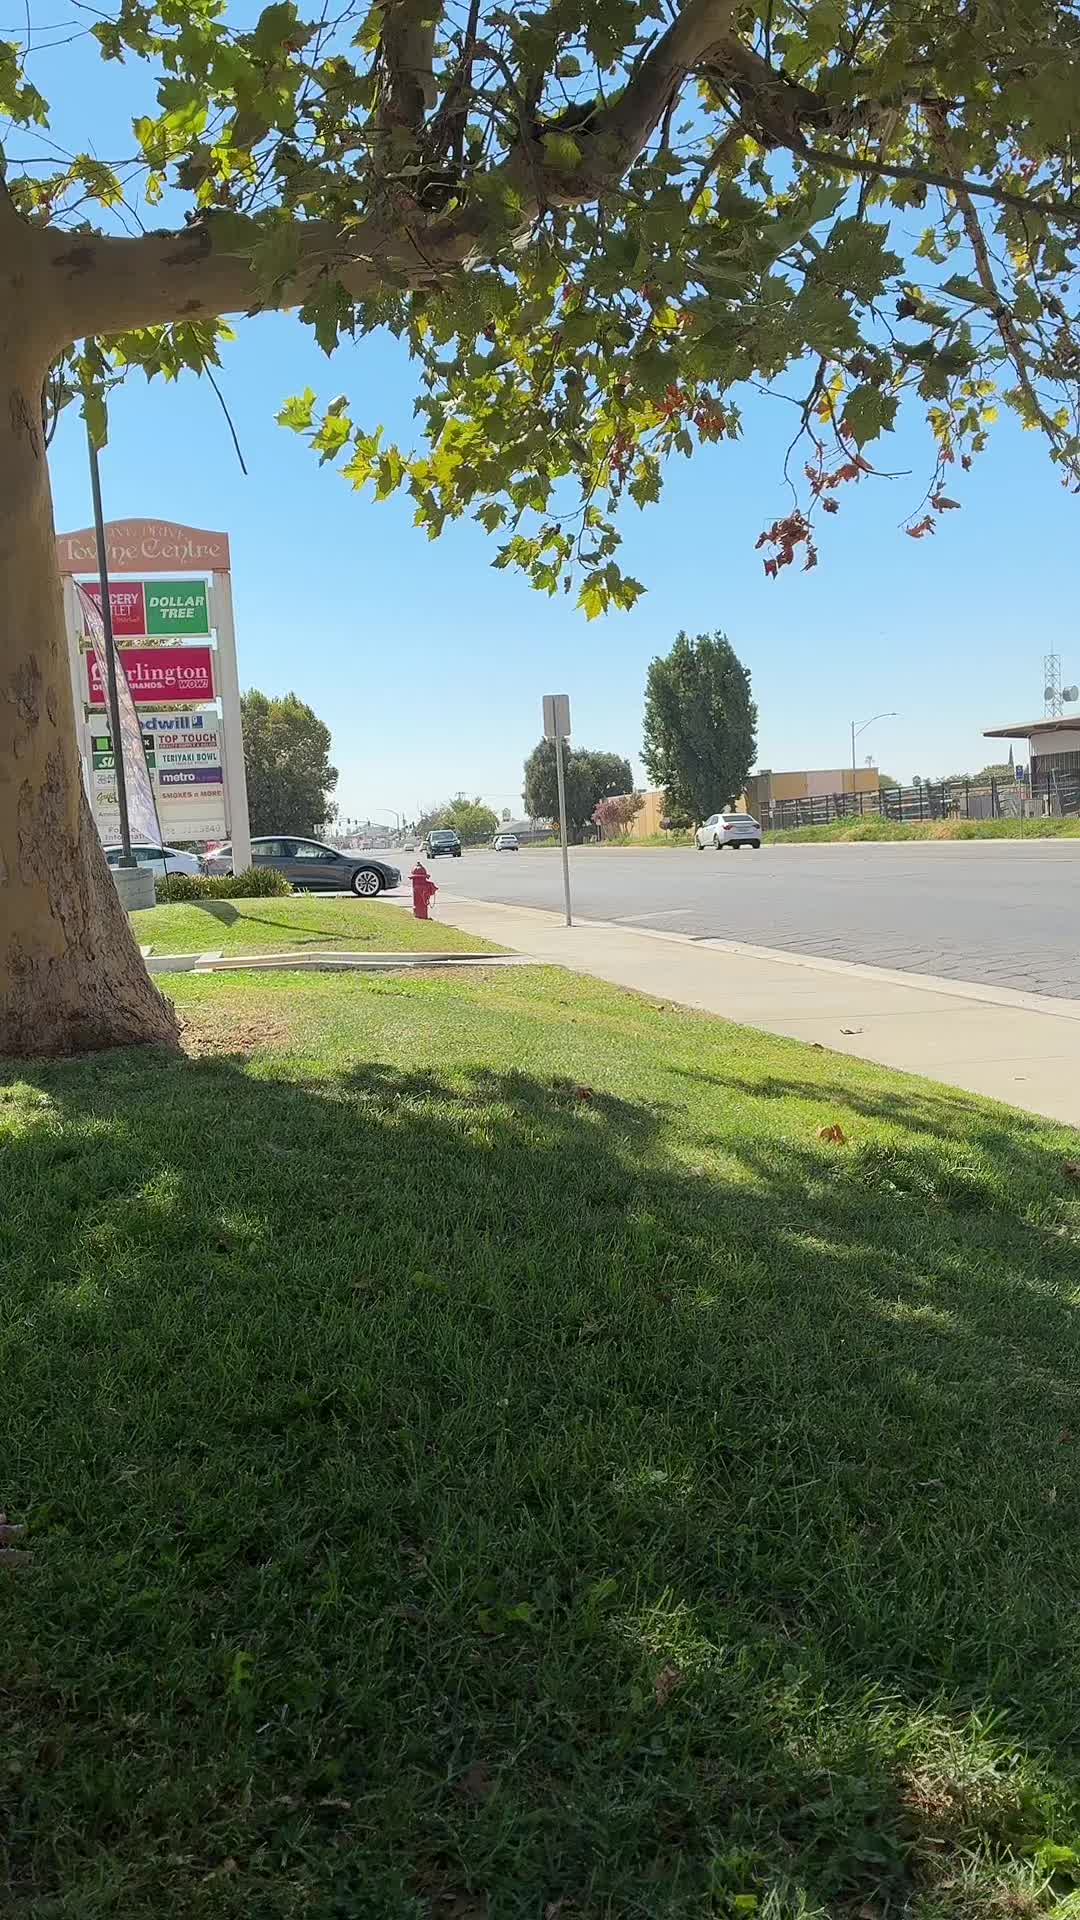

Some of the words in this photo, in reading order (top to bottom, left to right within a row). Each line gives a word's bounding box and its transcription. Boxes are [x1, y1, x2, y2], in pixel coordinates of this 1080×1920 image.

[141, 538, 221, 564] Centre
[149, 596, 205, 608] DOLLAR
[160, 608, 195, 619] TREE
[179, 680, 208, 689] WOW!
[158, 735, 178, 744] TOP
[181, 733, 217, 742] TOUCH
[162, 754, 195, 763] TERIYAKI
[196, 752, 217, 761] BOWL
[162, 773, 196, 782] metro
[161, 791, 193, 800] SMOKES
[200, 790, 222, 798] MORE
